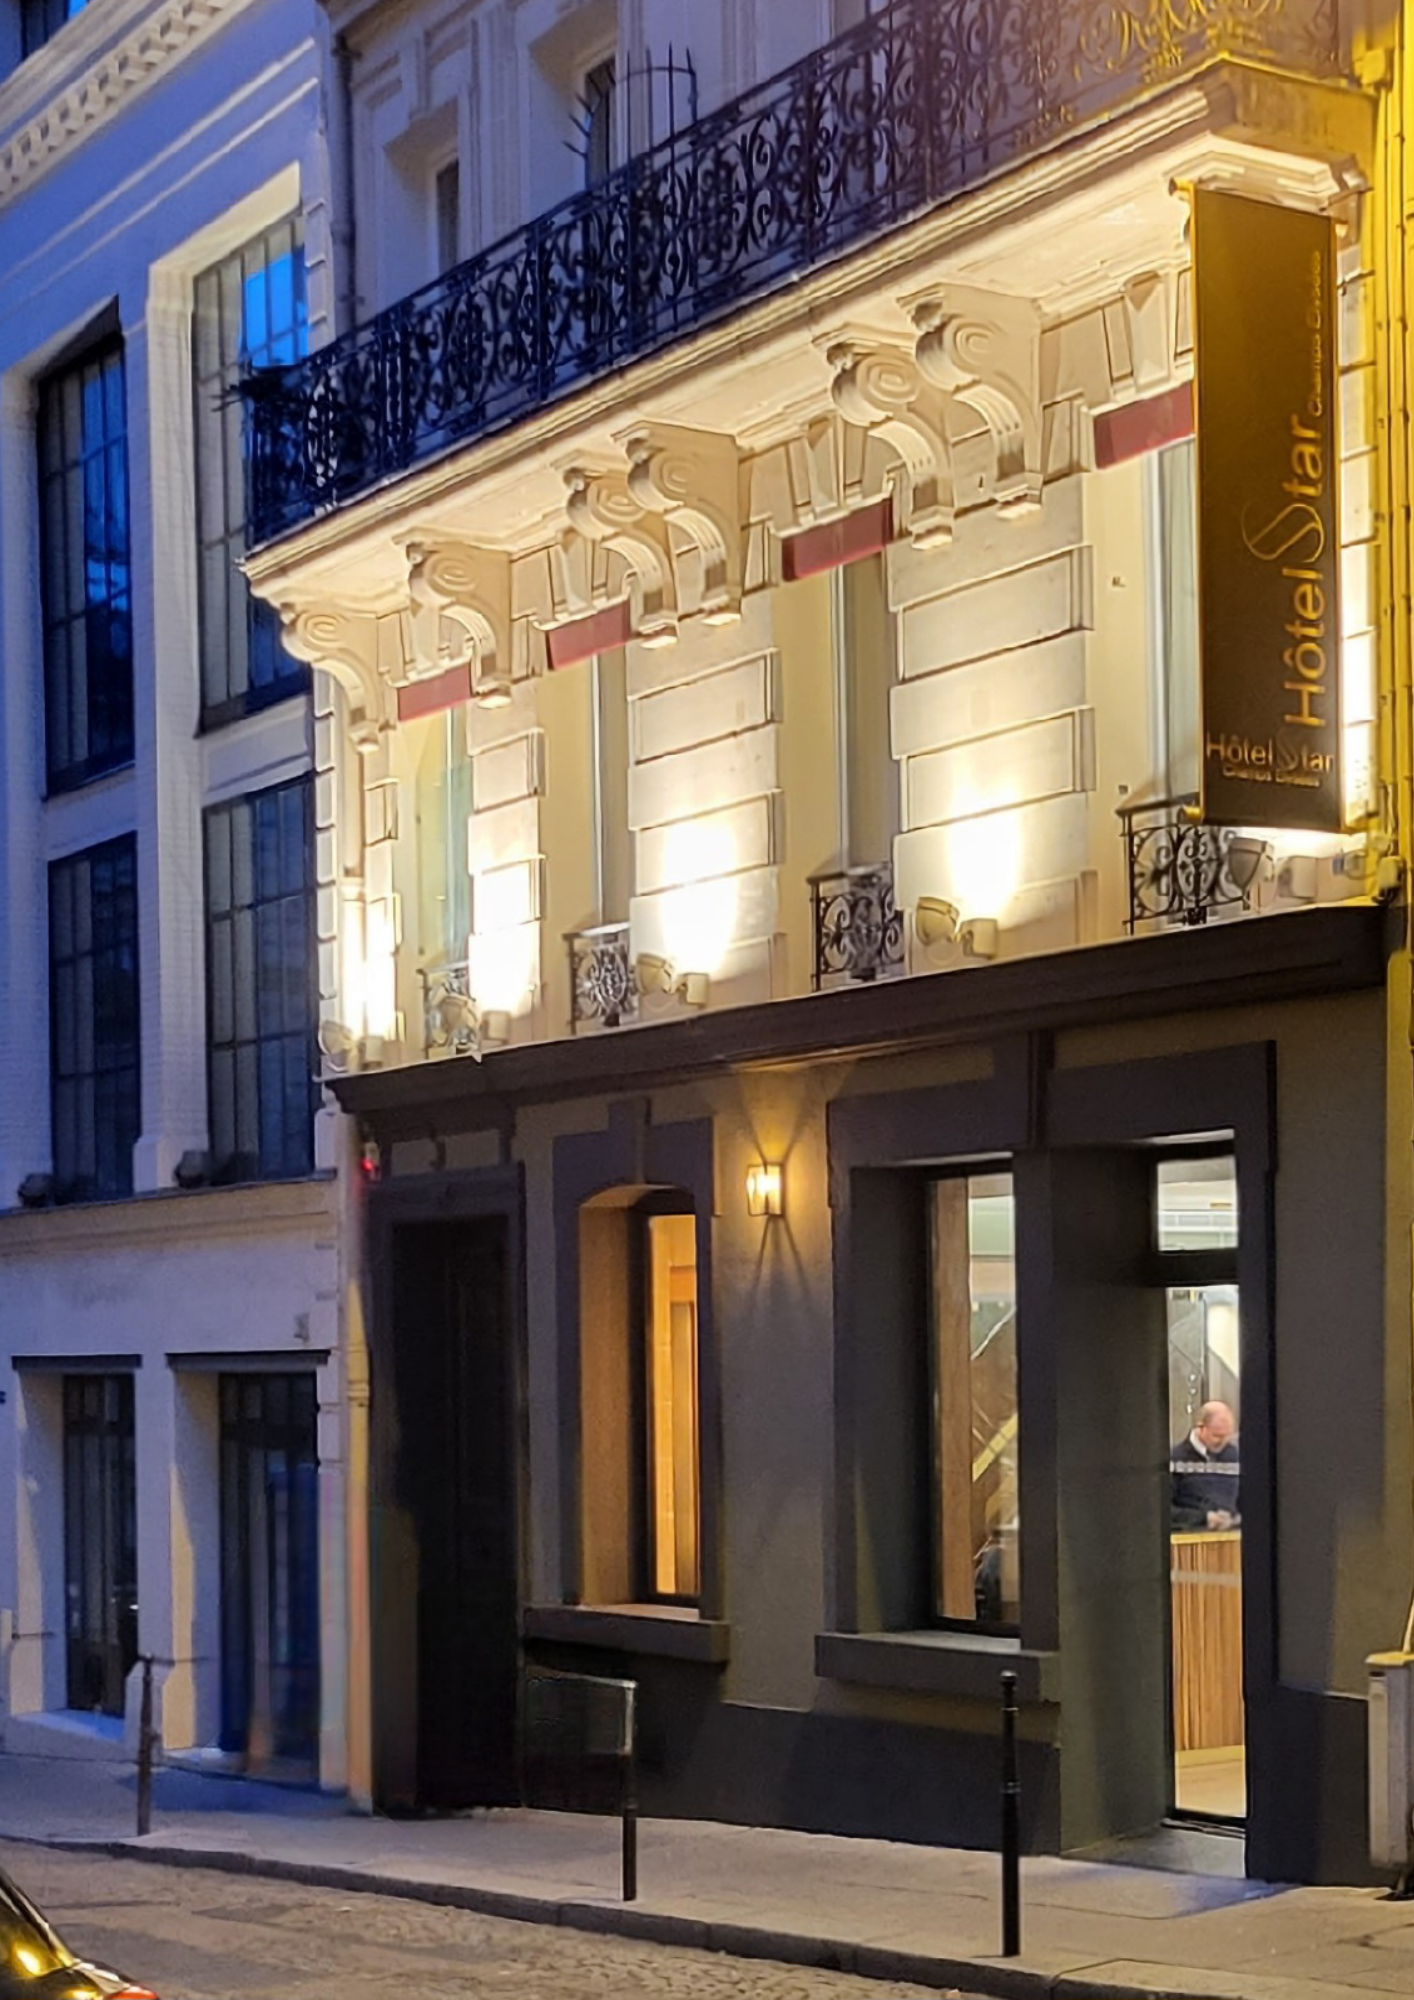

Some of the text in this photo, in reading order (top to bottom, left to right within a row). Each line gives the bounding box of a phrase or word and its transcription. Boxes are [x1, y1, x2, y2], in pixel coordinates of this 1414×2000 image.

[1241, 413, 1324, 563] Star
[1282, 568, 1326, 727] Hôtel
[1206, 725, 1334, 774] Hôtel Star
